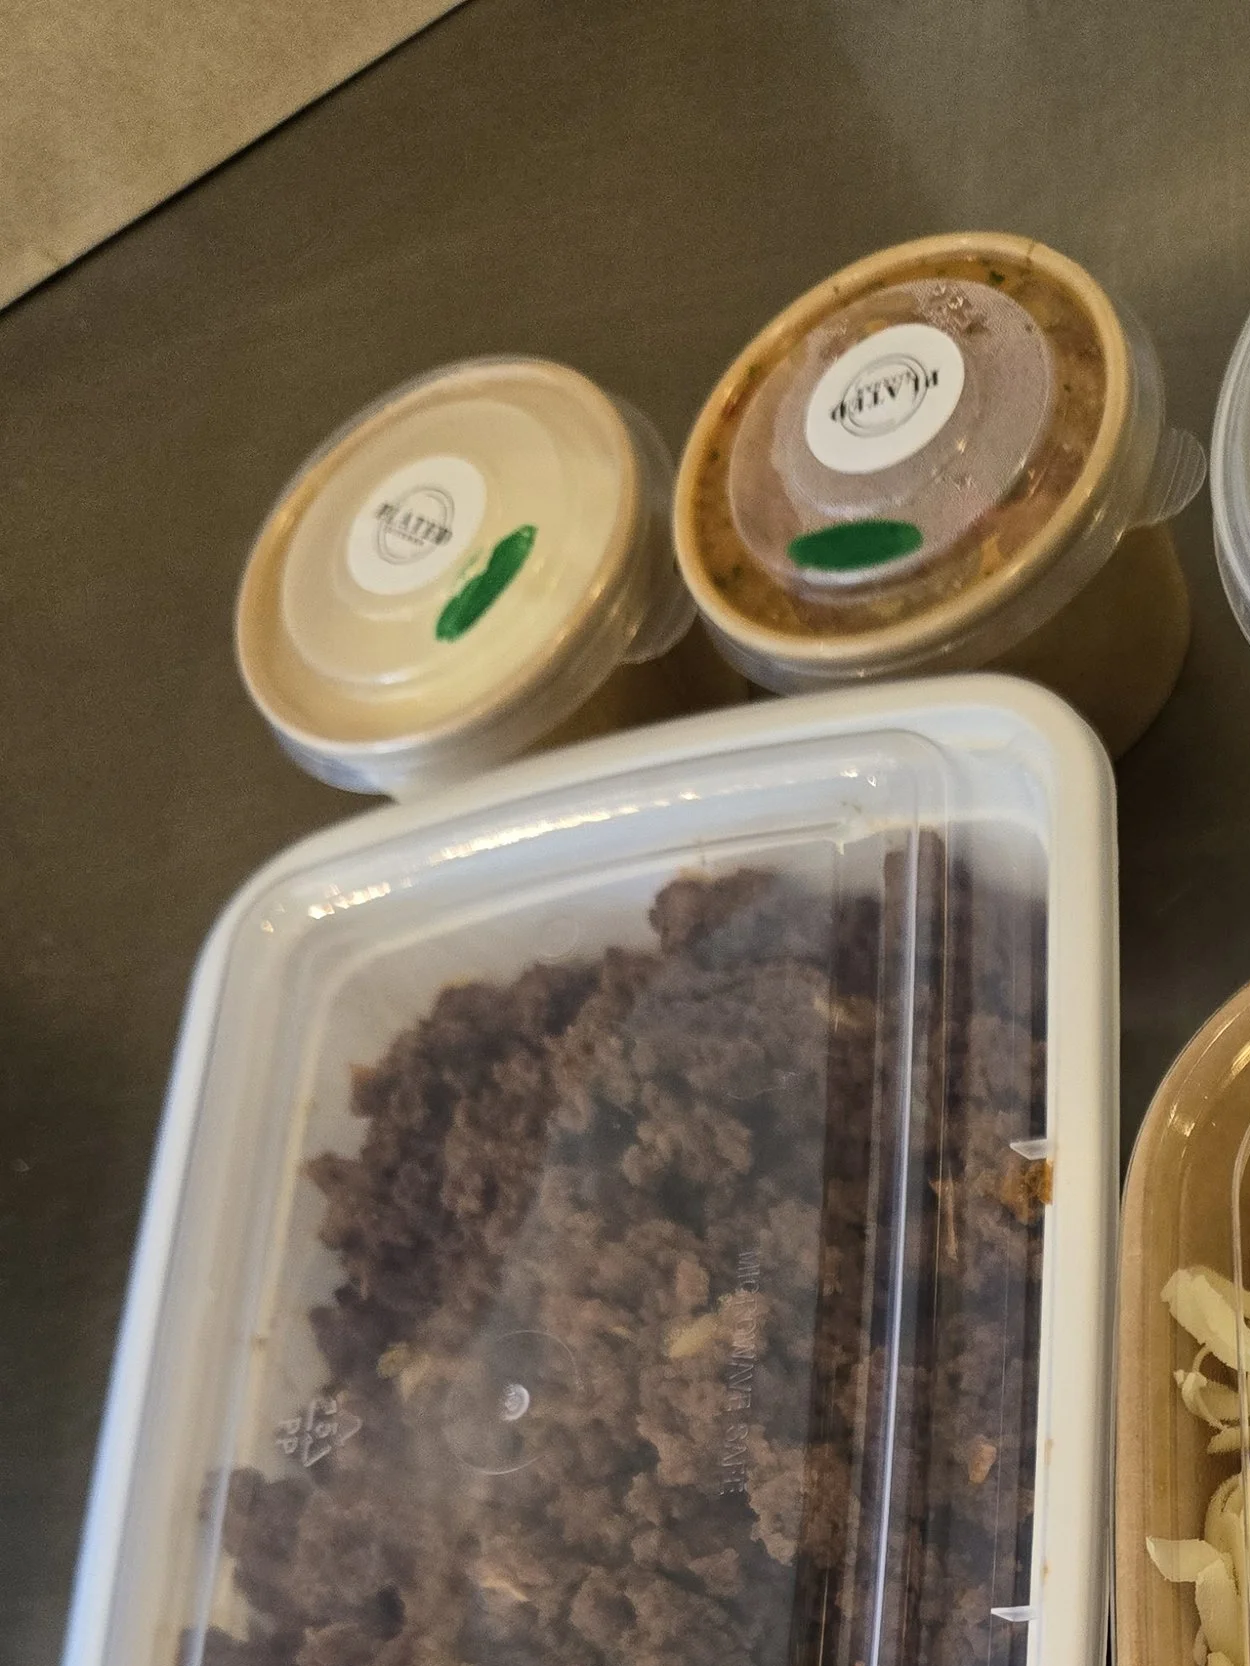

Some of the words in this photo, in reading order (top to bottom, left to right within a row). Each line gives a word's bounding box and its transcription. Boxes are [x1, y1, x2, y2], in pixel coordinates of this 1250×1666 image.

[830, 370, 939, 421] PLATED
[726, 1251, 760, 1412] MICROWAVE
[719, 1424, 749, 1496] SAFE
